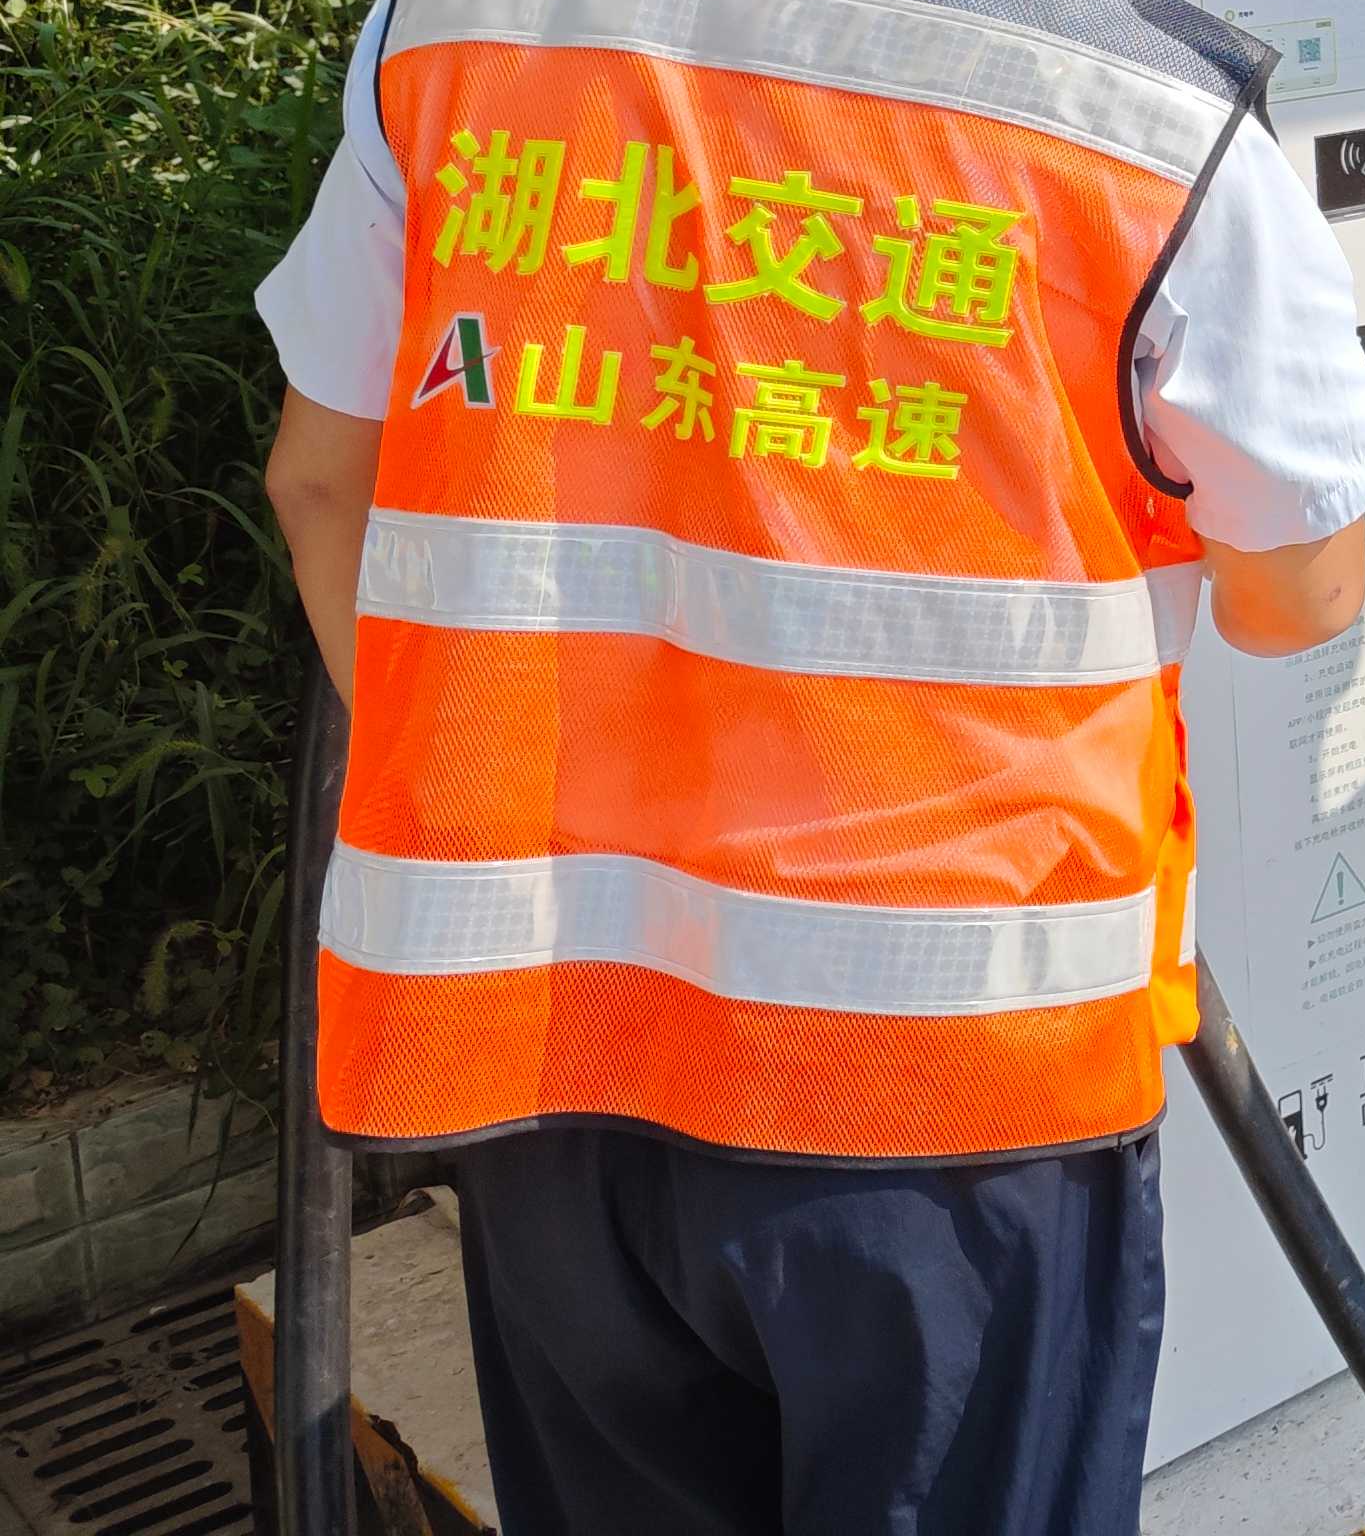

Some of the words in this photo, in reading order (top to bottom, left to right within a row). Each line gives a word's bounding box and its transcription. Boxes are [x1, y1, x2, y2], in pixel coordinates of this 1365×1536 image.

[432, 128, 1033, 349] 湖北交通
[516, 324, 970, 481] 山东高速
